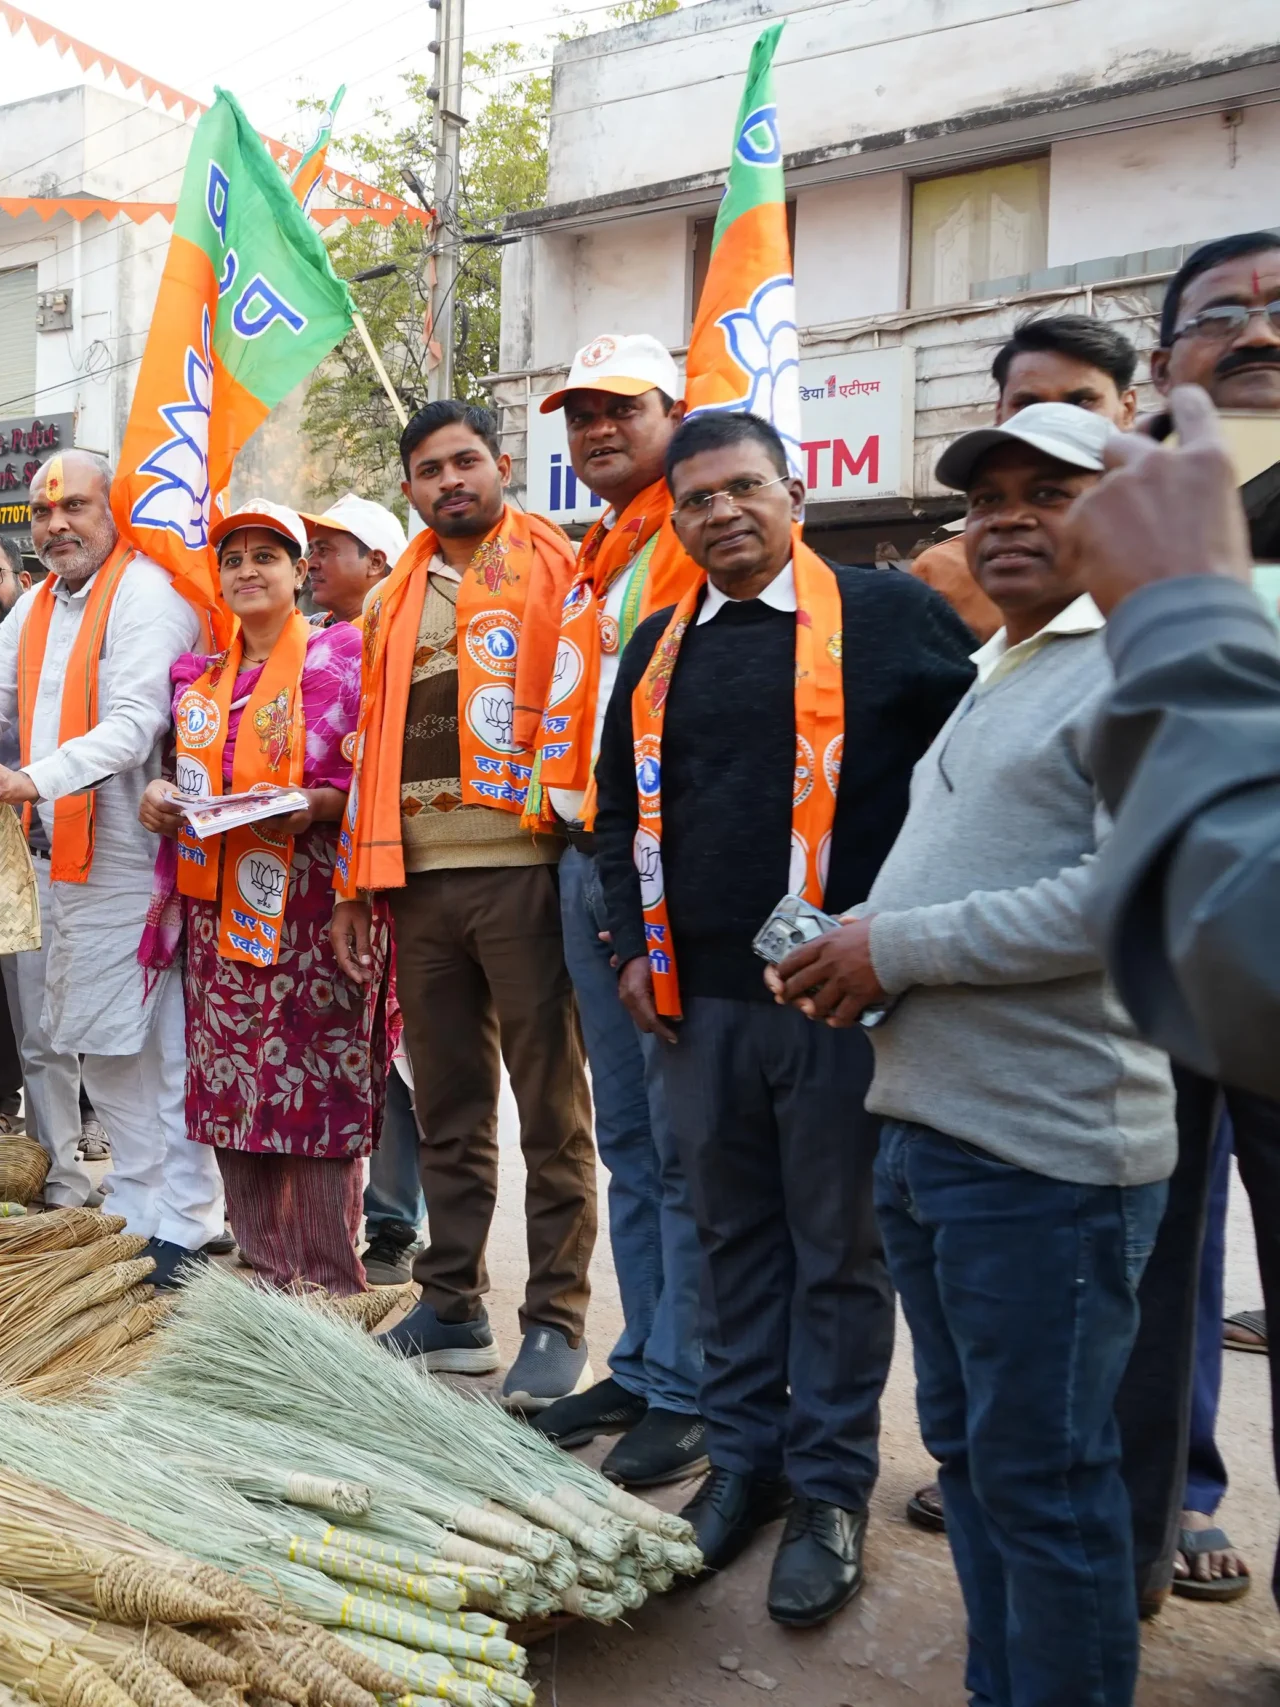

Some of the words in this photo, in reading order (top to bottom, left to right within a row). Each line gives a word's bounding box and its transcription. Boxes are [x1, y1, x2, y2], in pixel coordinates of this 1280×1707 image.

[839, 379, 881, 398] एटीएम
[800, 434, 880, 490] TM
[473, 755, 503, 775] हर
[231, 909, 258, 932] घर
